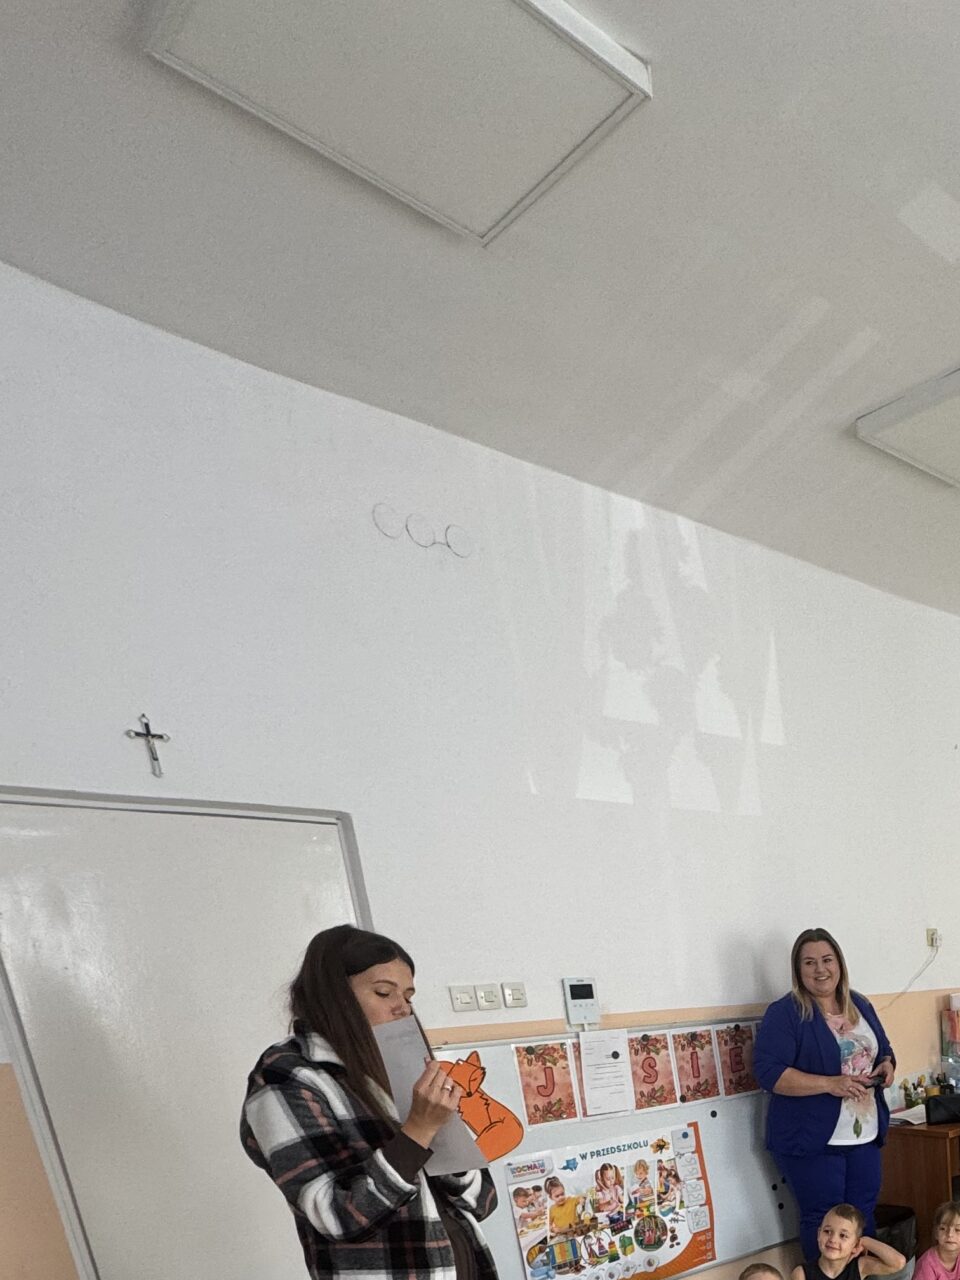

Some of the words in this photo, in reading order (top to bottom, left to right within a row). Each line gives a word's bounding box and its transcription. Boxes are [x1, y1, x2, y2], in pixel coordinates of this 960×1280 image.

[580, 1153, 588, 1161] W
[590, 1140, 649, 1159] PRZEDSZKOLU
[510, 1160, 545, 1174] KOCHAM
